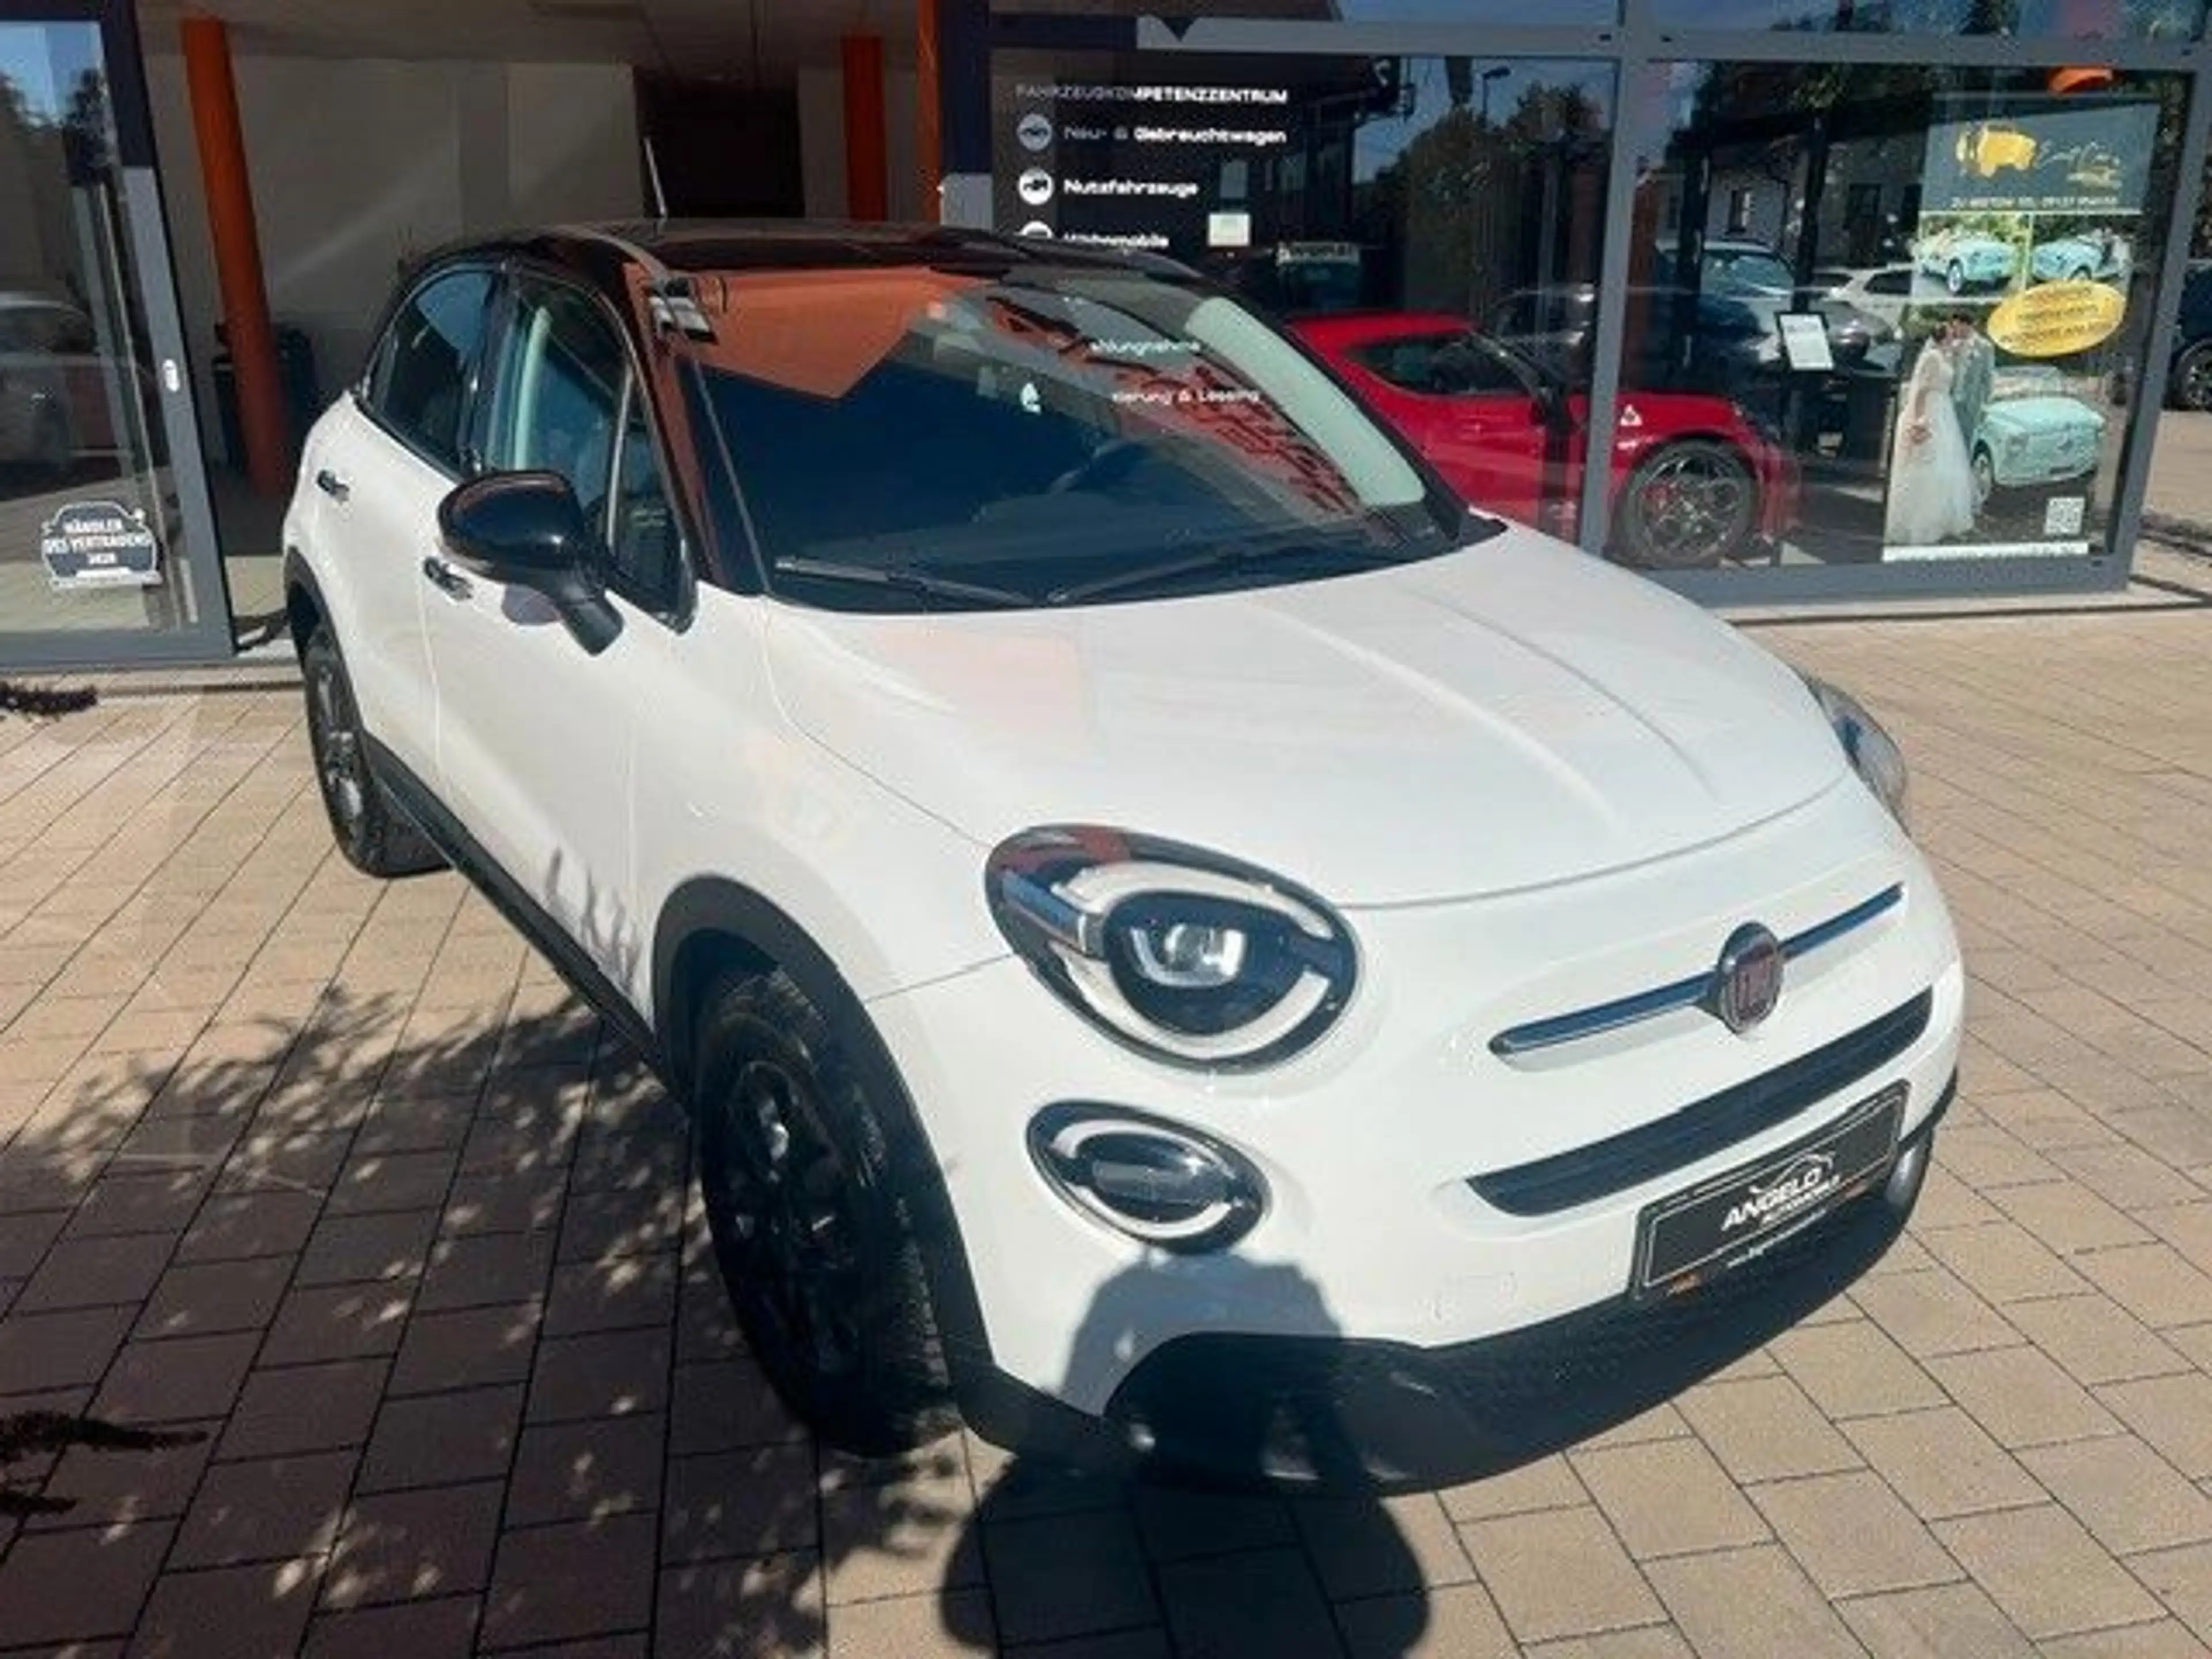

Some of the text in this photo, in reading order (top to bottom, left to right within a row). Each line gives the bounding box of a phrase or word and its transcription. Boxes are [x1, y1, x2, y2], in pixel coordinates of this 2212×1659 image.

[1134, 126, 1287, 146] Gebrauchtwagen
[1064, 179, 1198, 199] Nutzfahrzeuge
[1721, 1166, 1823, 1232] ANGELO
